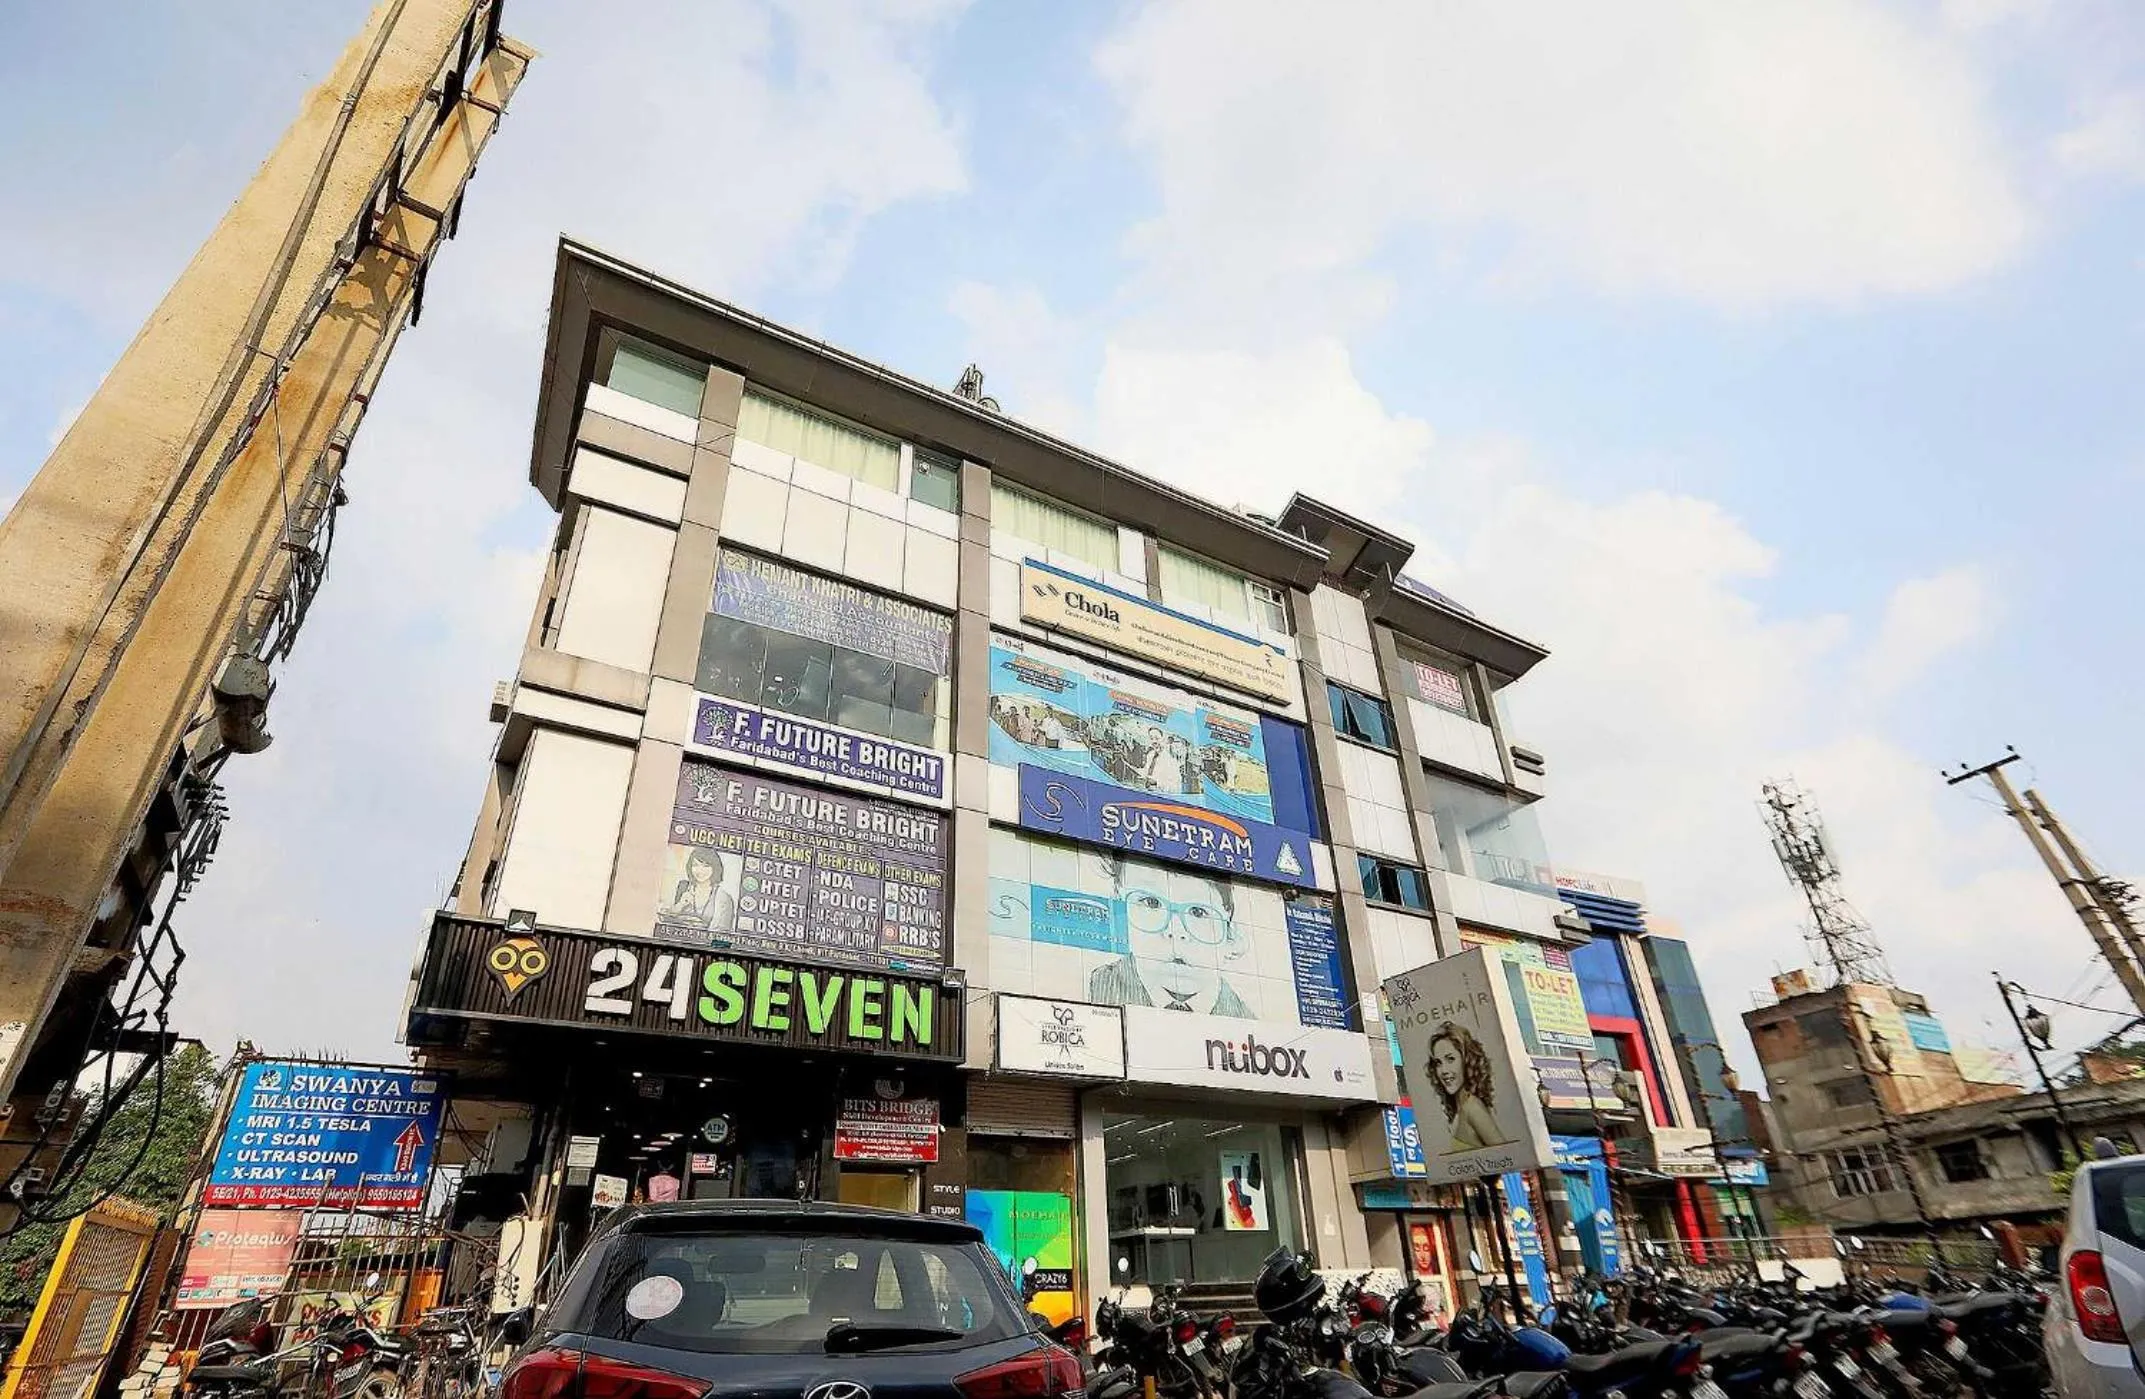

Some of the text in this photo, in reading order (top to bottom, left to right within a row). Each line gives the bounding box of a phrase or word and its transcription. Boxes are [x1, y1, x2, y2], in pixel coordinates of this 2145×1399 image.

[811, 575, 860, 605] KHATRI
[862, 594, 873, 608] &
[876, 596, 953, 635] ASSOCIATES
[1065, 592, 1120, 622] Chola
[734, 711, 940, 781] F. FUTURE BRIGHT
[730, 735, 938, 795] Faridabad's Best Coaching Centre
[726, 780, 745, 803] F.
[753, 786, 849, 826] FUTURE
[855, 808, 940, 844] BRIGHT
[689, 828, 744, 851] UGC NET
[725, 803, 938, 854] Faridabad's Best Coaching Centre
[1101, 805, 1253, 859] SUNETRAM
[748, 838, 813, 865] TET EXAMS
[1102, 829, 1254, 873] EYE CARE
[762, 860, 803, 880] CTET
[819, 871, 854, 891] NDA
[760, 878, 802, 899] HTET
[899, 884, 930, 905] SSC
[757, 898, 806, 920] UPTET
[817, 889, 878, 914] POLICE
[756, 917, 806, 940] DSSSB
[899, 905, 942, 929] BANKING
[898, 925, 942, 949] RRB'S
[1041, 1029, 1085, 1046] ROBICA
[290, 1074, 401, 1096] SWANYA
[250, 1093, 431, 1116] IMAGING CENTRE
[844, 1098, 933, 1115] BITS BRIDGE
[246, 1115, 281, 1128] MRI
[316, 1118, 372, 1132] TESLA
[241, 1132, 320, 1146] CT SCAN
[236, 1150, 358, 1164] ULTRASOUND
[230, 1166, 286, 1180] X-RAY
[930, 1205, 961, 1216] STUDIO
